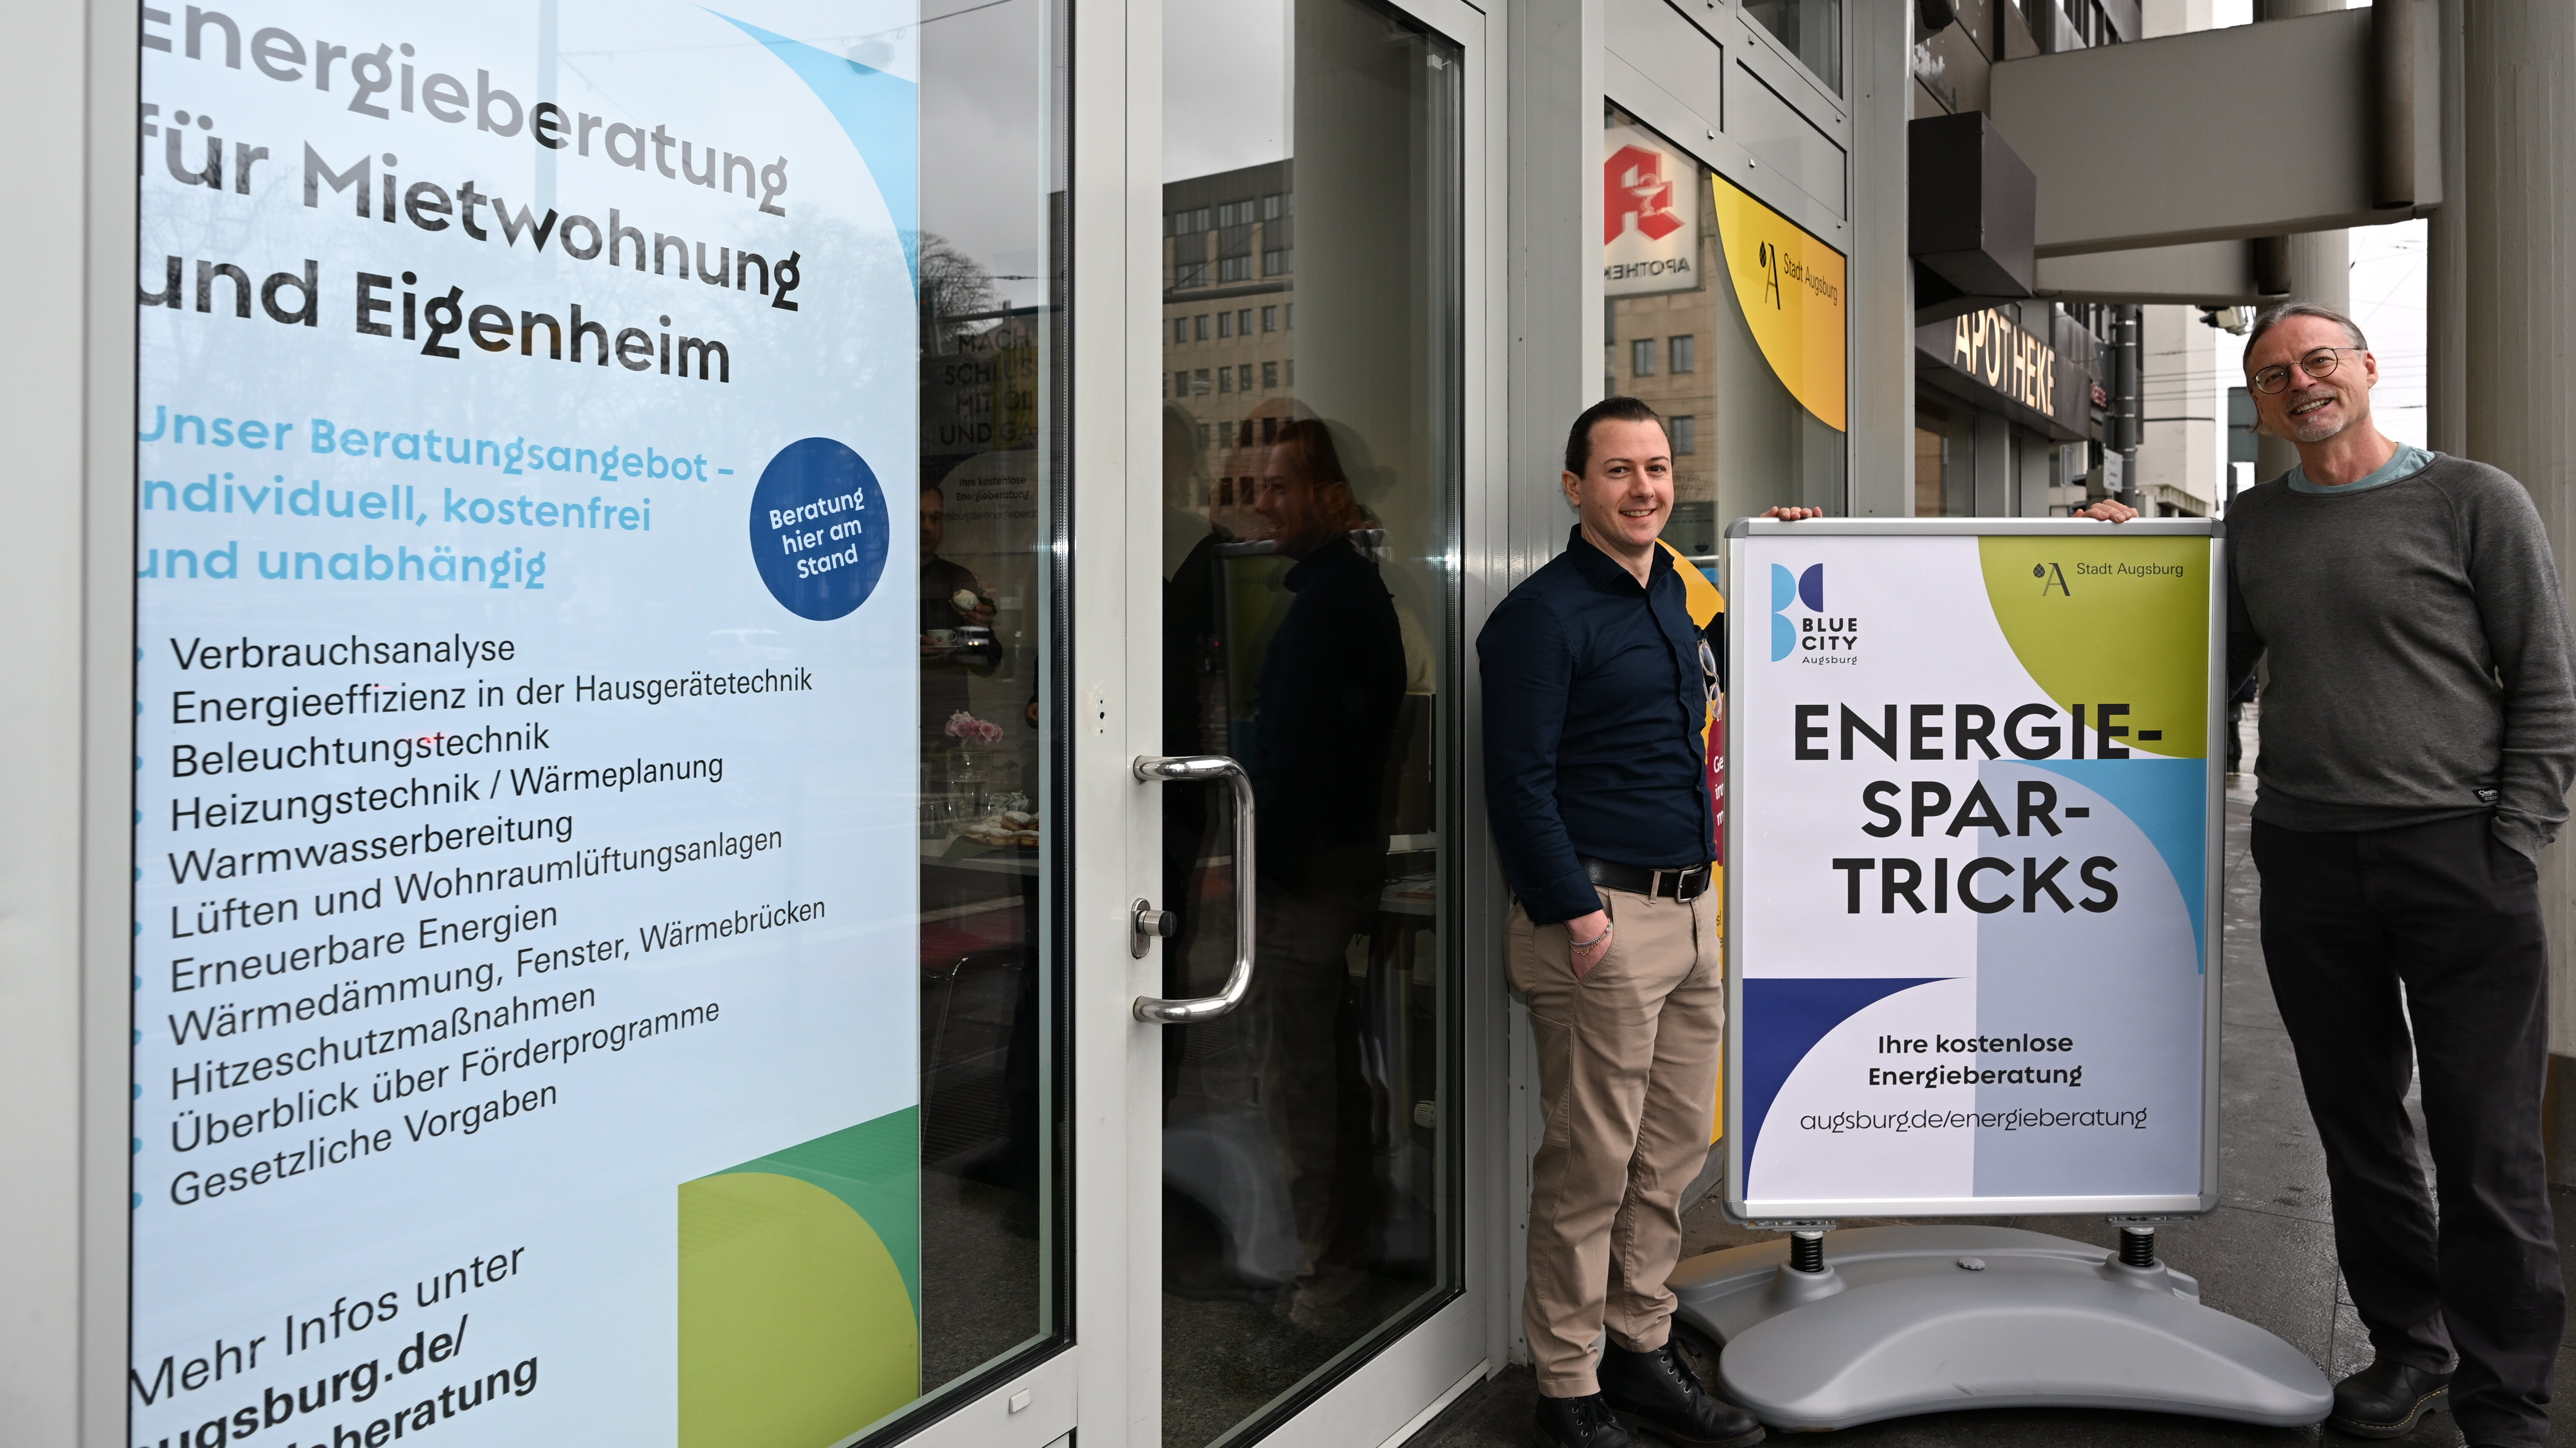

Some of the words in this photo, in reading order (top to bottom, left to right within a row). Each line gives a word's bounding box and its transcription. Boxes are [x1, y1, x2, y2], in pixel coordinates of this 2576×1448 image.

[304, 140, 801, 312] Mietwohnung
[1784, 253, 1803, 283] Stadt
[1805, 266, 1837, 305] Augsburg
[356, 271, 729, 383] Eigenheim
[945, 358, 1038, 386] SCHLUS
[1954, 308, 2055, 417] APOTHEKE
[312, 418, 709, 483] Beratungsangebot
[1001, 420, 1038, 442] GA
[144, 472, 428, 527] ndividuell,
[443, 488, 651, 532] kostenfrei
[770, 487, 864, 529] Beratung
[258, 545, 547, 589] unabhängig
[782, 529, 824, 555] hier
[830, 520, 862, 540] am
[797, 543, 858, 578] Stand
[2077, 562, 2112, 575] Stadt
[2117, 562, 2183, 577] Augsburg
[170, 634, 515, 671] Verbrauchsanalyse
[1802, 636, 1858, 650] CITY
[1803, 618, 1857, 632] BLUE
[1802, 655, 1858, 665] Augsburg
[172, 682, 466, 728] Energieeffizienz
[478, 681, 504, 708] in
[515, 677, 566, 706] der
[576, 668, 813, 705] Hausgerätetechnik
[172, 722, 550, 778] Beleuchtungstechnik
[1795, 702, 2162, 762] ENERGIE-
[172, 770, 480, 832] Heizungstechnik
[511, 754, 724, 797] Wärmeplanung
[1861, 779, 2089, 838] SPAR-
[168, 810, 573, 885] Warmwasserbereitung
[172, 889, 298, 939] Lüften
[315, 878, 381, 917] und
[395, 827, 782, 906] Wohnraumlüftungsanlagen
[1833, 856, 2119, 914] TRICKS
[168, 954, 503, 1046] Wärmedämmung,
[516, 934, 630, 978] Fenster,
[640, 896, 825, 954] Wärmebrücken
[172, 923, 405, 993] Erneuerbare
[420, 903, 558, 951] Energien
[172, 984, 596, 1100] Hitzeschutzmaßnahmen
[1878, 1035, 1928, 1054] Ihre
[1936, 1033, 2073, 1053] kostenlose
[172, 1080, 360, 1152] Überblick
[372, 1063, 450, 1104] über
[462, 997, 719, 1084] Förderprogramme
[1869, 1065, 2082, 1088] Energieberatung
[171, 1124, 392, 1206] Gesetzliche
[404, 1079, 557, 1144] Vorgaben
[1800, 1107, 2147, 1133] augsburg.de/energieberatung
[131, 1336, 266, 1406] Mehr
[286, 1292, 397, 1356] Infos
[417, 1247, 524, 1306] unter
[136, 1314, 468, 1448] gsburg.de/
[287, 1356, 538, 1448] beratung
